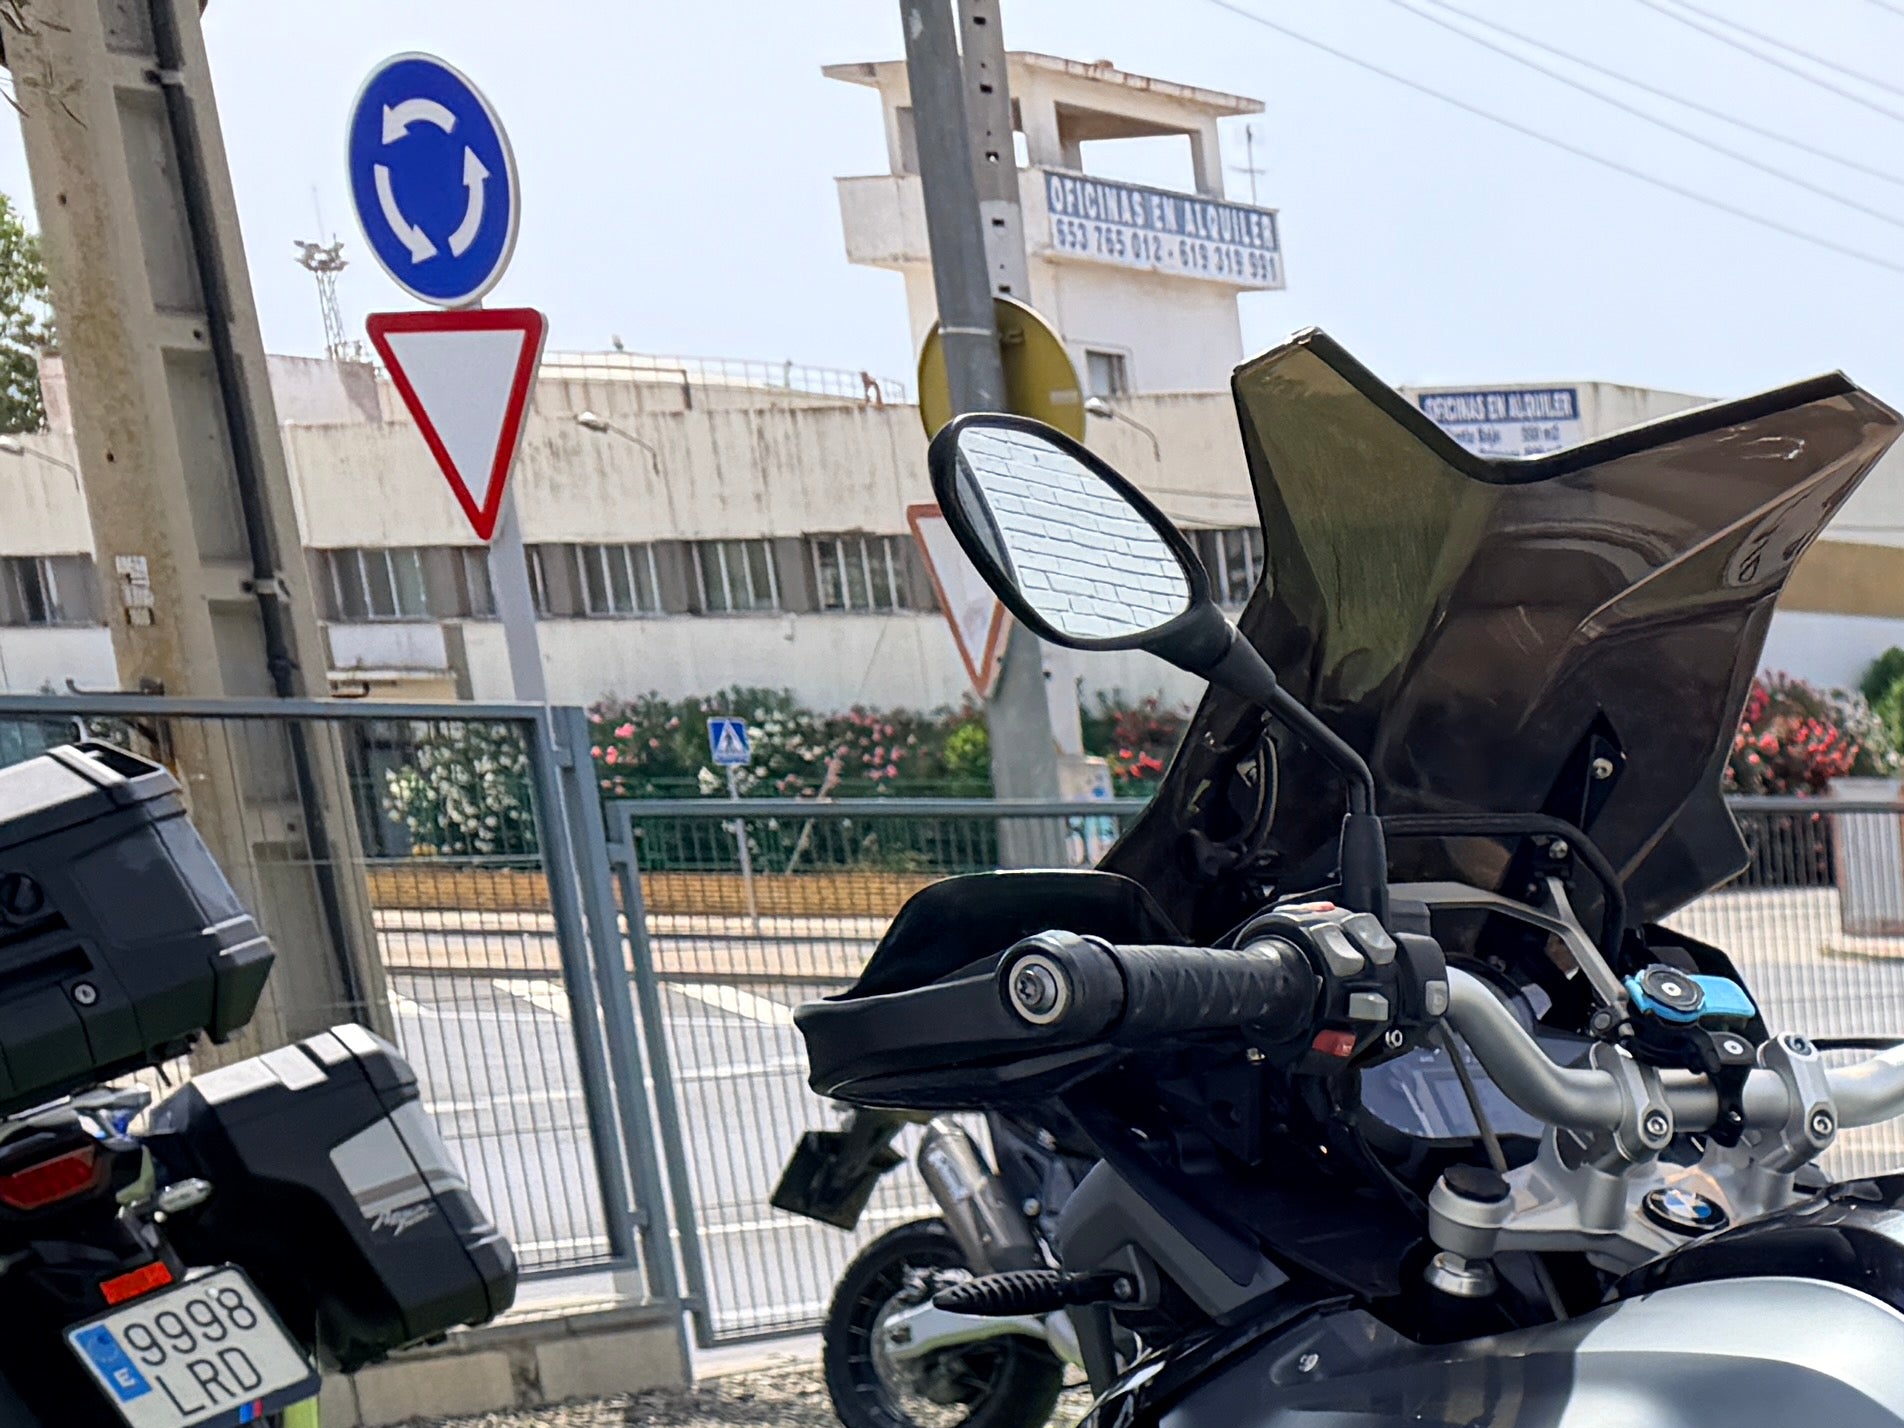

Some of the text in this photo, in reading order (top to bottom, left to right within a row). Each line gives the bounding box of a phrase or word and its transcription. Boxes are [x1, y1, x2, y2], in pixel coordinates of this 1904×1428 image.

[1050, 176, 1276, 248] OFICINAS EN ALQUILER
[1056, 218, 1088, 250] 653
[1094, 225, 1125, 257] 765
[1132, 231, 1162, 263] 012
[1180, 239, 1209, 270] 619
[123, 1287, 258, 1366] 9998
[114, 1367, 136, 1388] E
[155, 1346, 263, 1417] LRD
